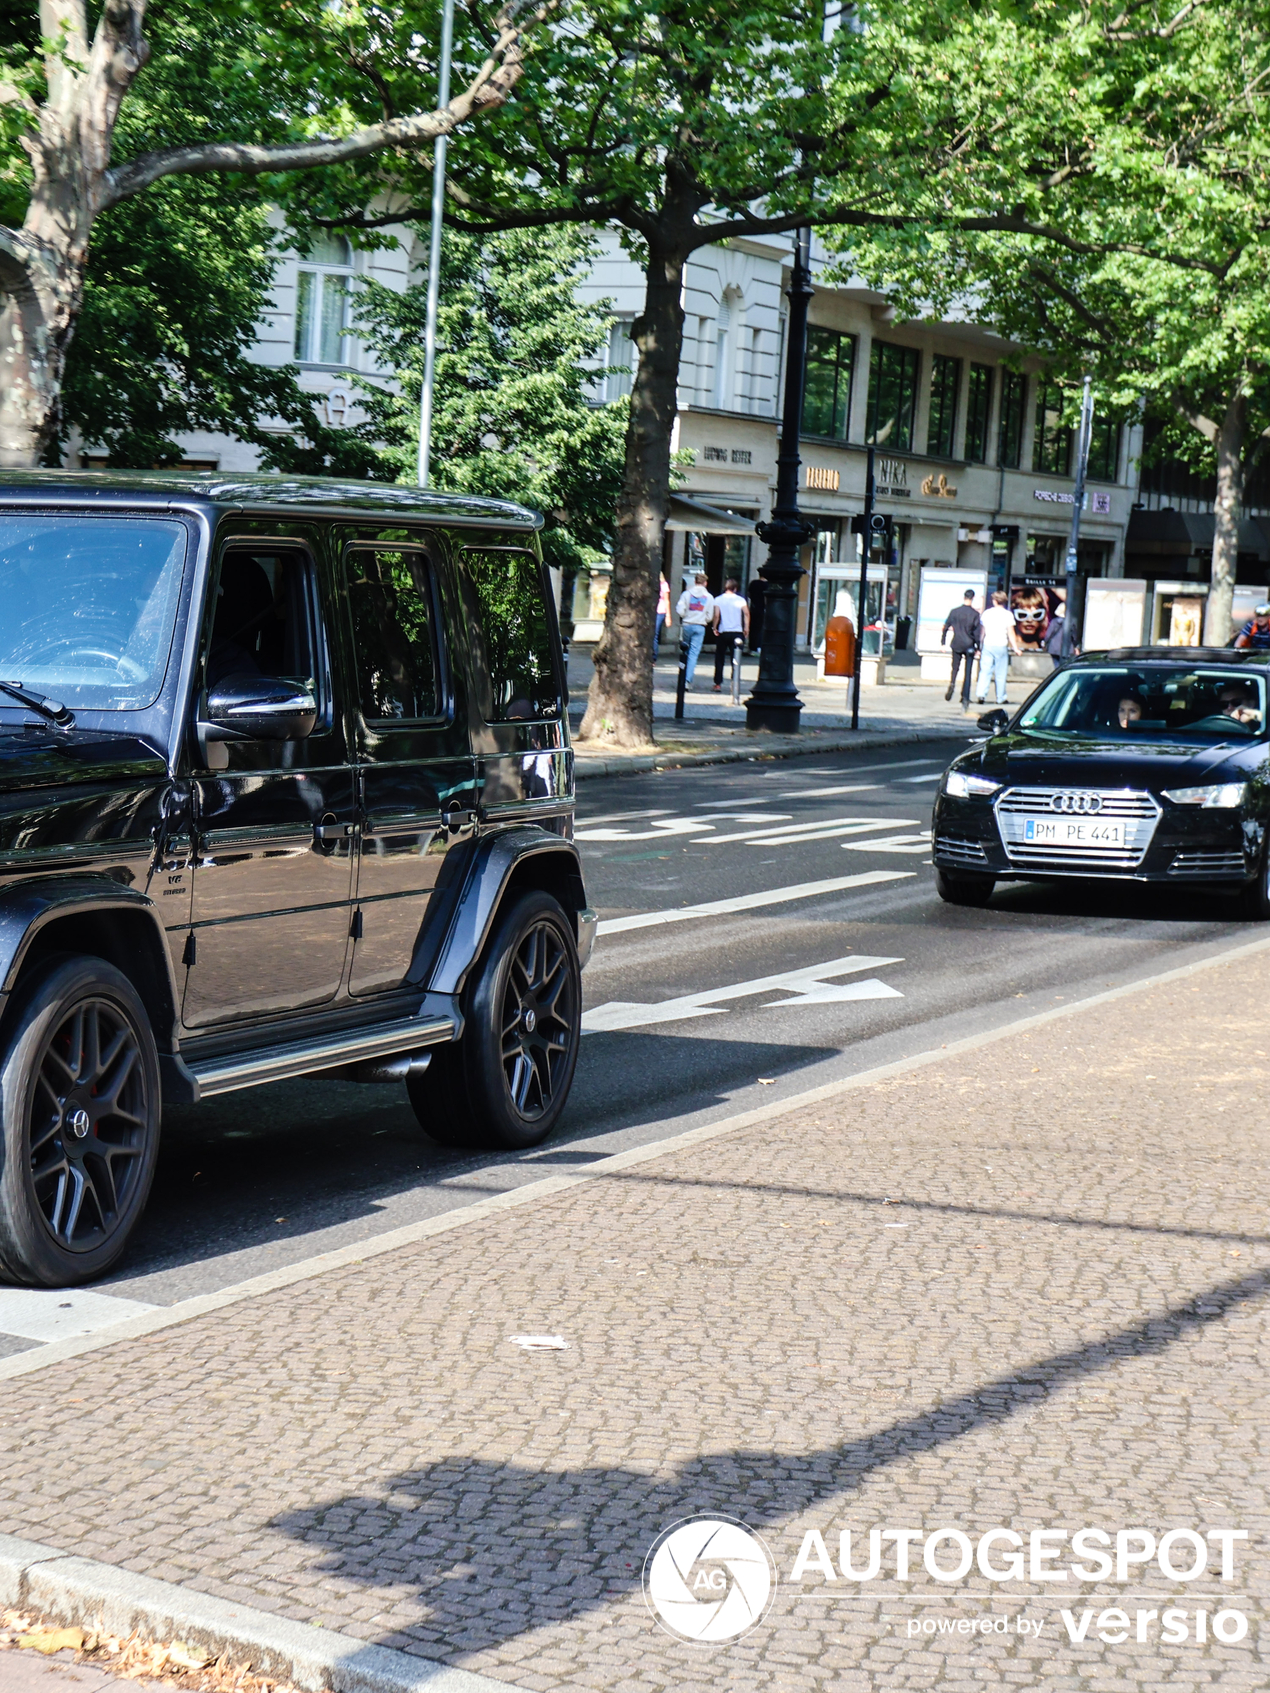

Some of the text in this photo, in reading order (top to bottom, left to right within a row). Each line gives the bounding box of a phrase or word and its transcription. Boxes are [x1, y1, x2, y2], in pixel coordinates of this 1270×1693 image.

[878, 460, 907, 485] NIKA
[1036, 824, 1120, 842] PM PE 441
